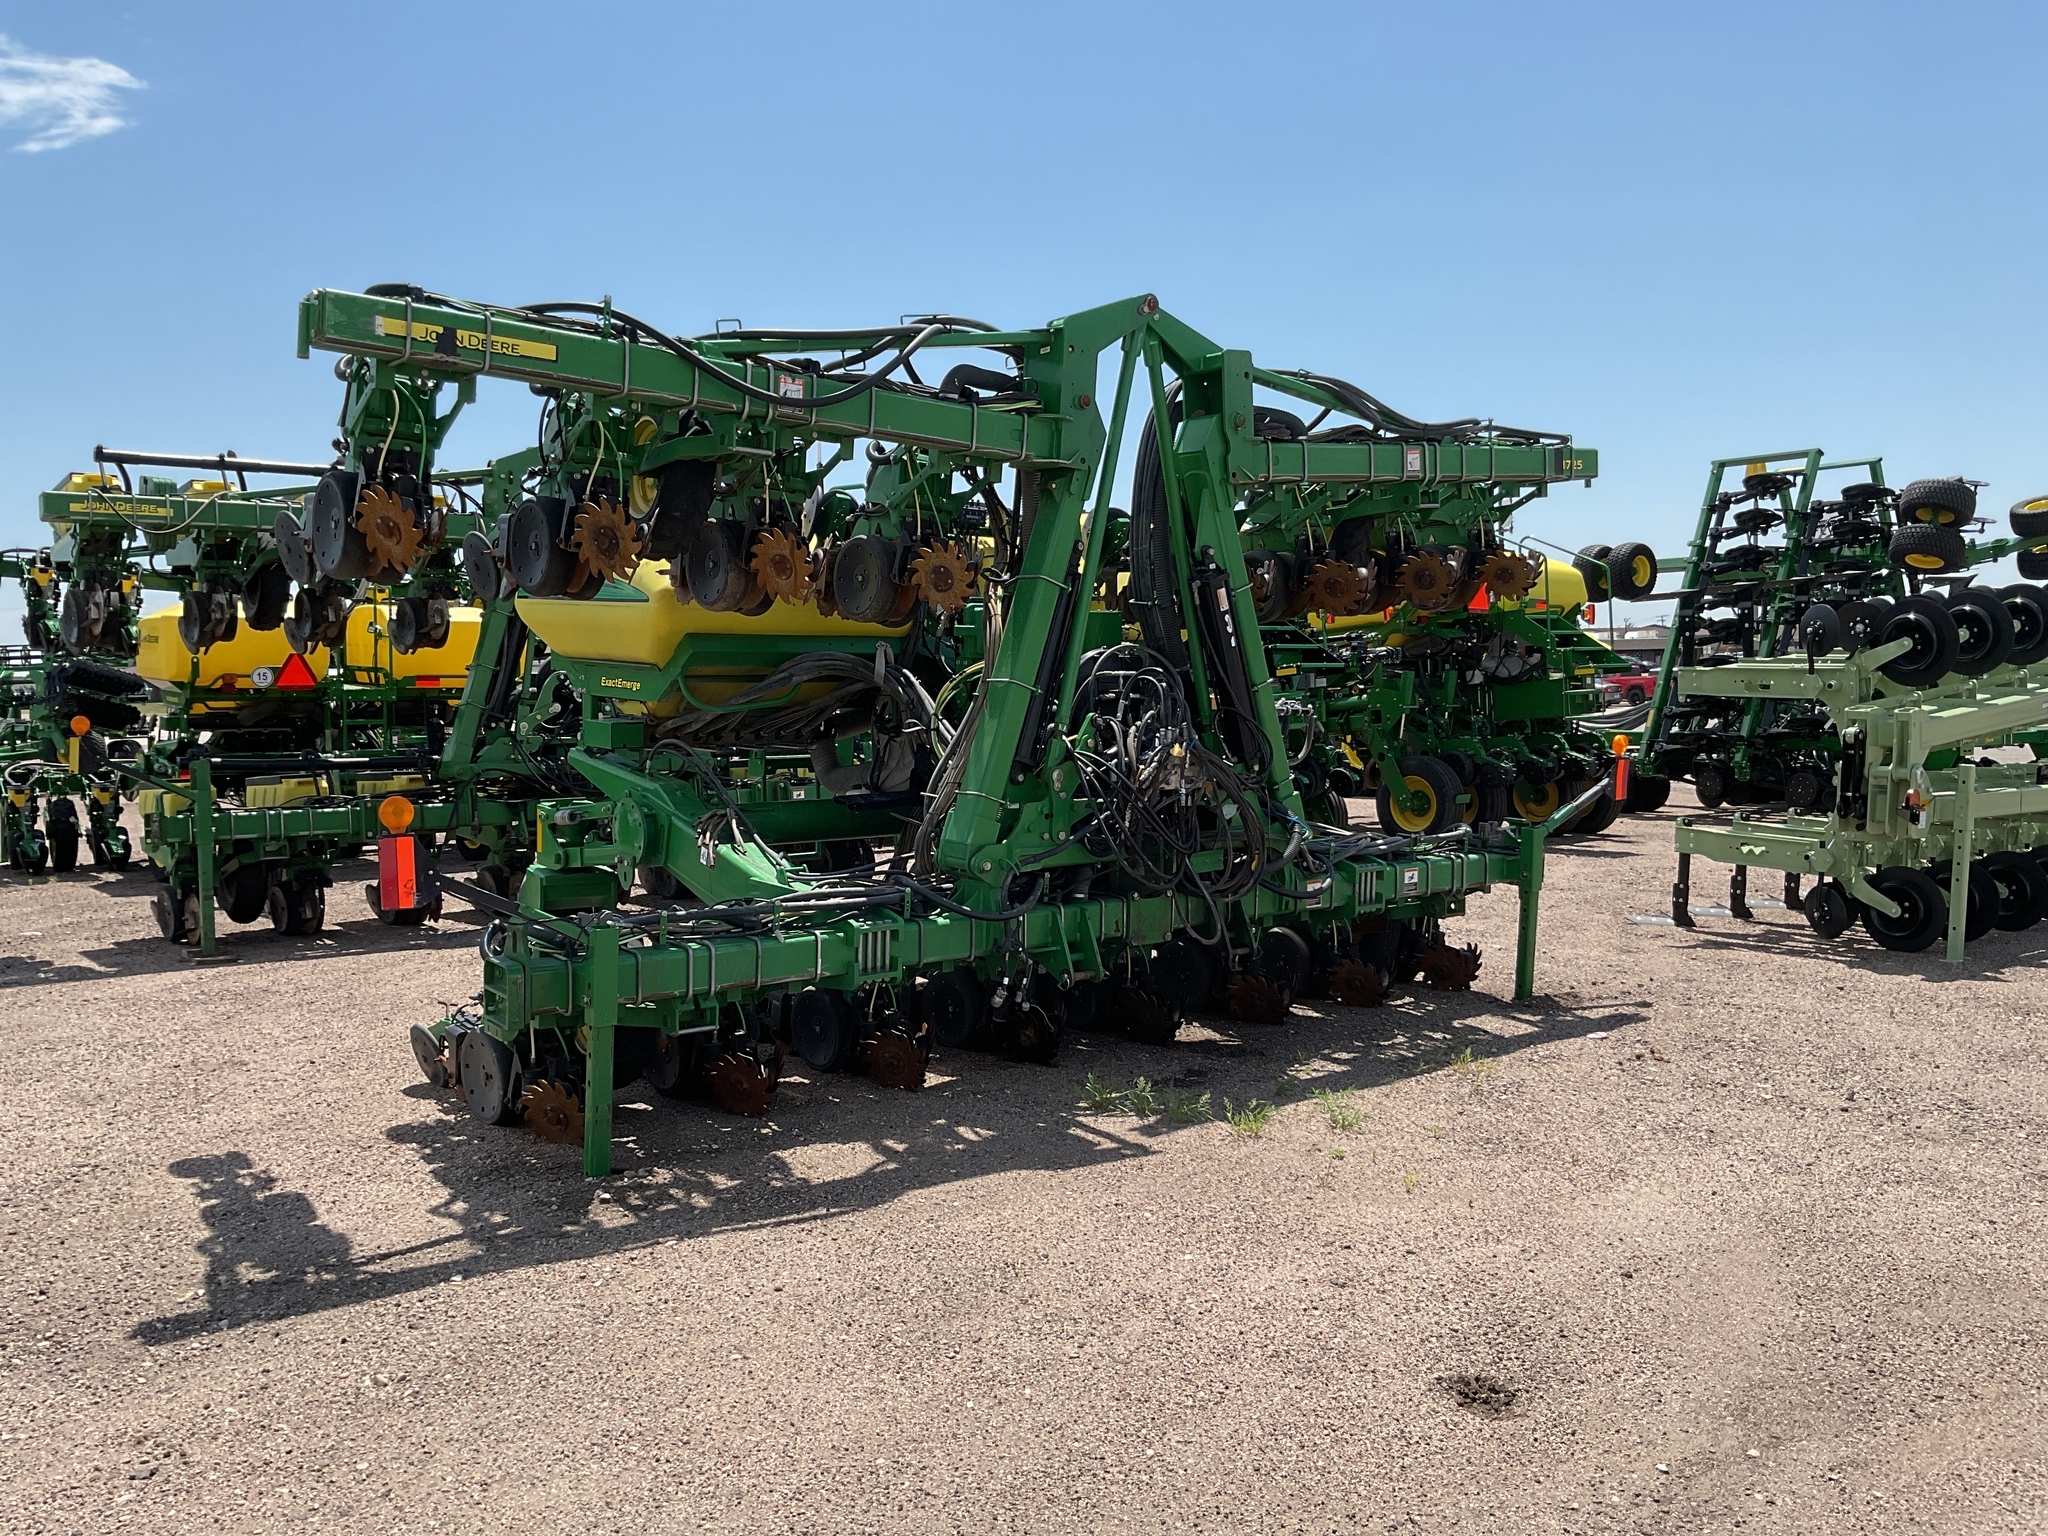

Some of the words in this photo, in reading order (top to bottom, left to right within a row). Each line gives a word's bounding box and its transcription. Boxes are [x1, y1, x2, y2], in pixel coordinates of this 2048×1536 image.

[419, 327, 463, 346] JON
[469, 334, 520, 354] DEERE
[1562, 459, 1582, 470] 1725
[116, 501, 158, 513] DEERE
[256, 671, 268, 681] 15
[601, 676, 641, 691] ExactEmerge
